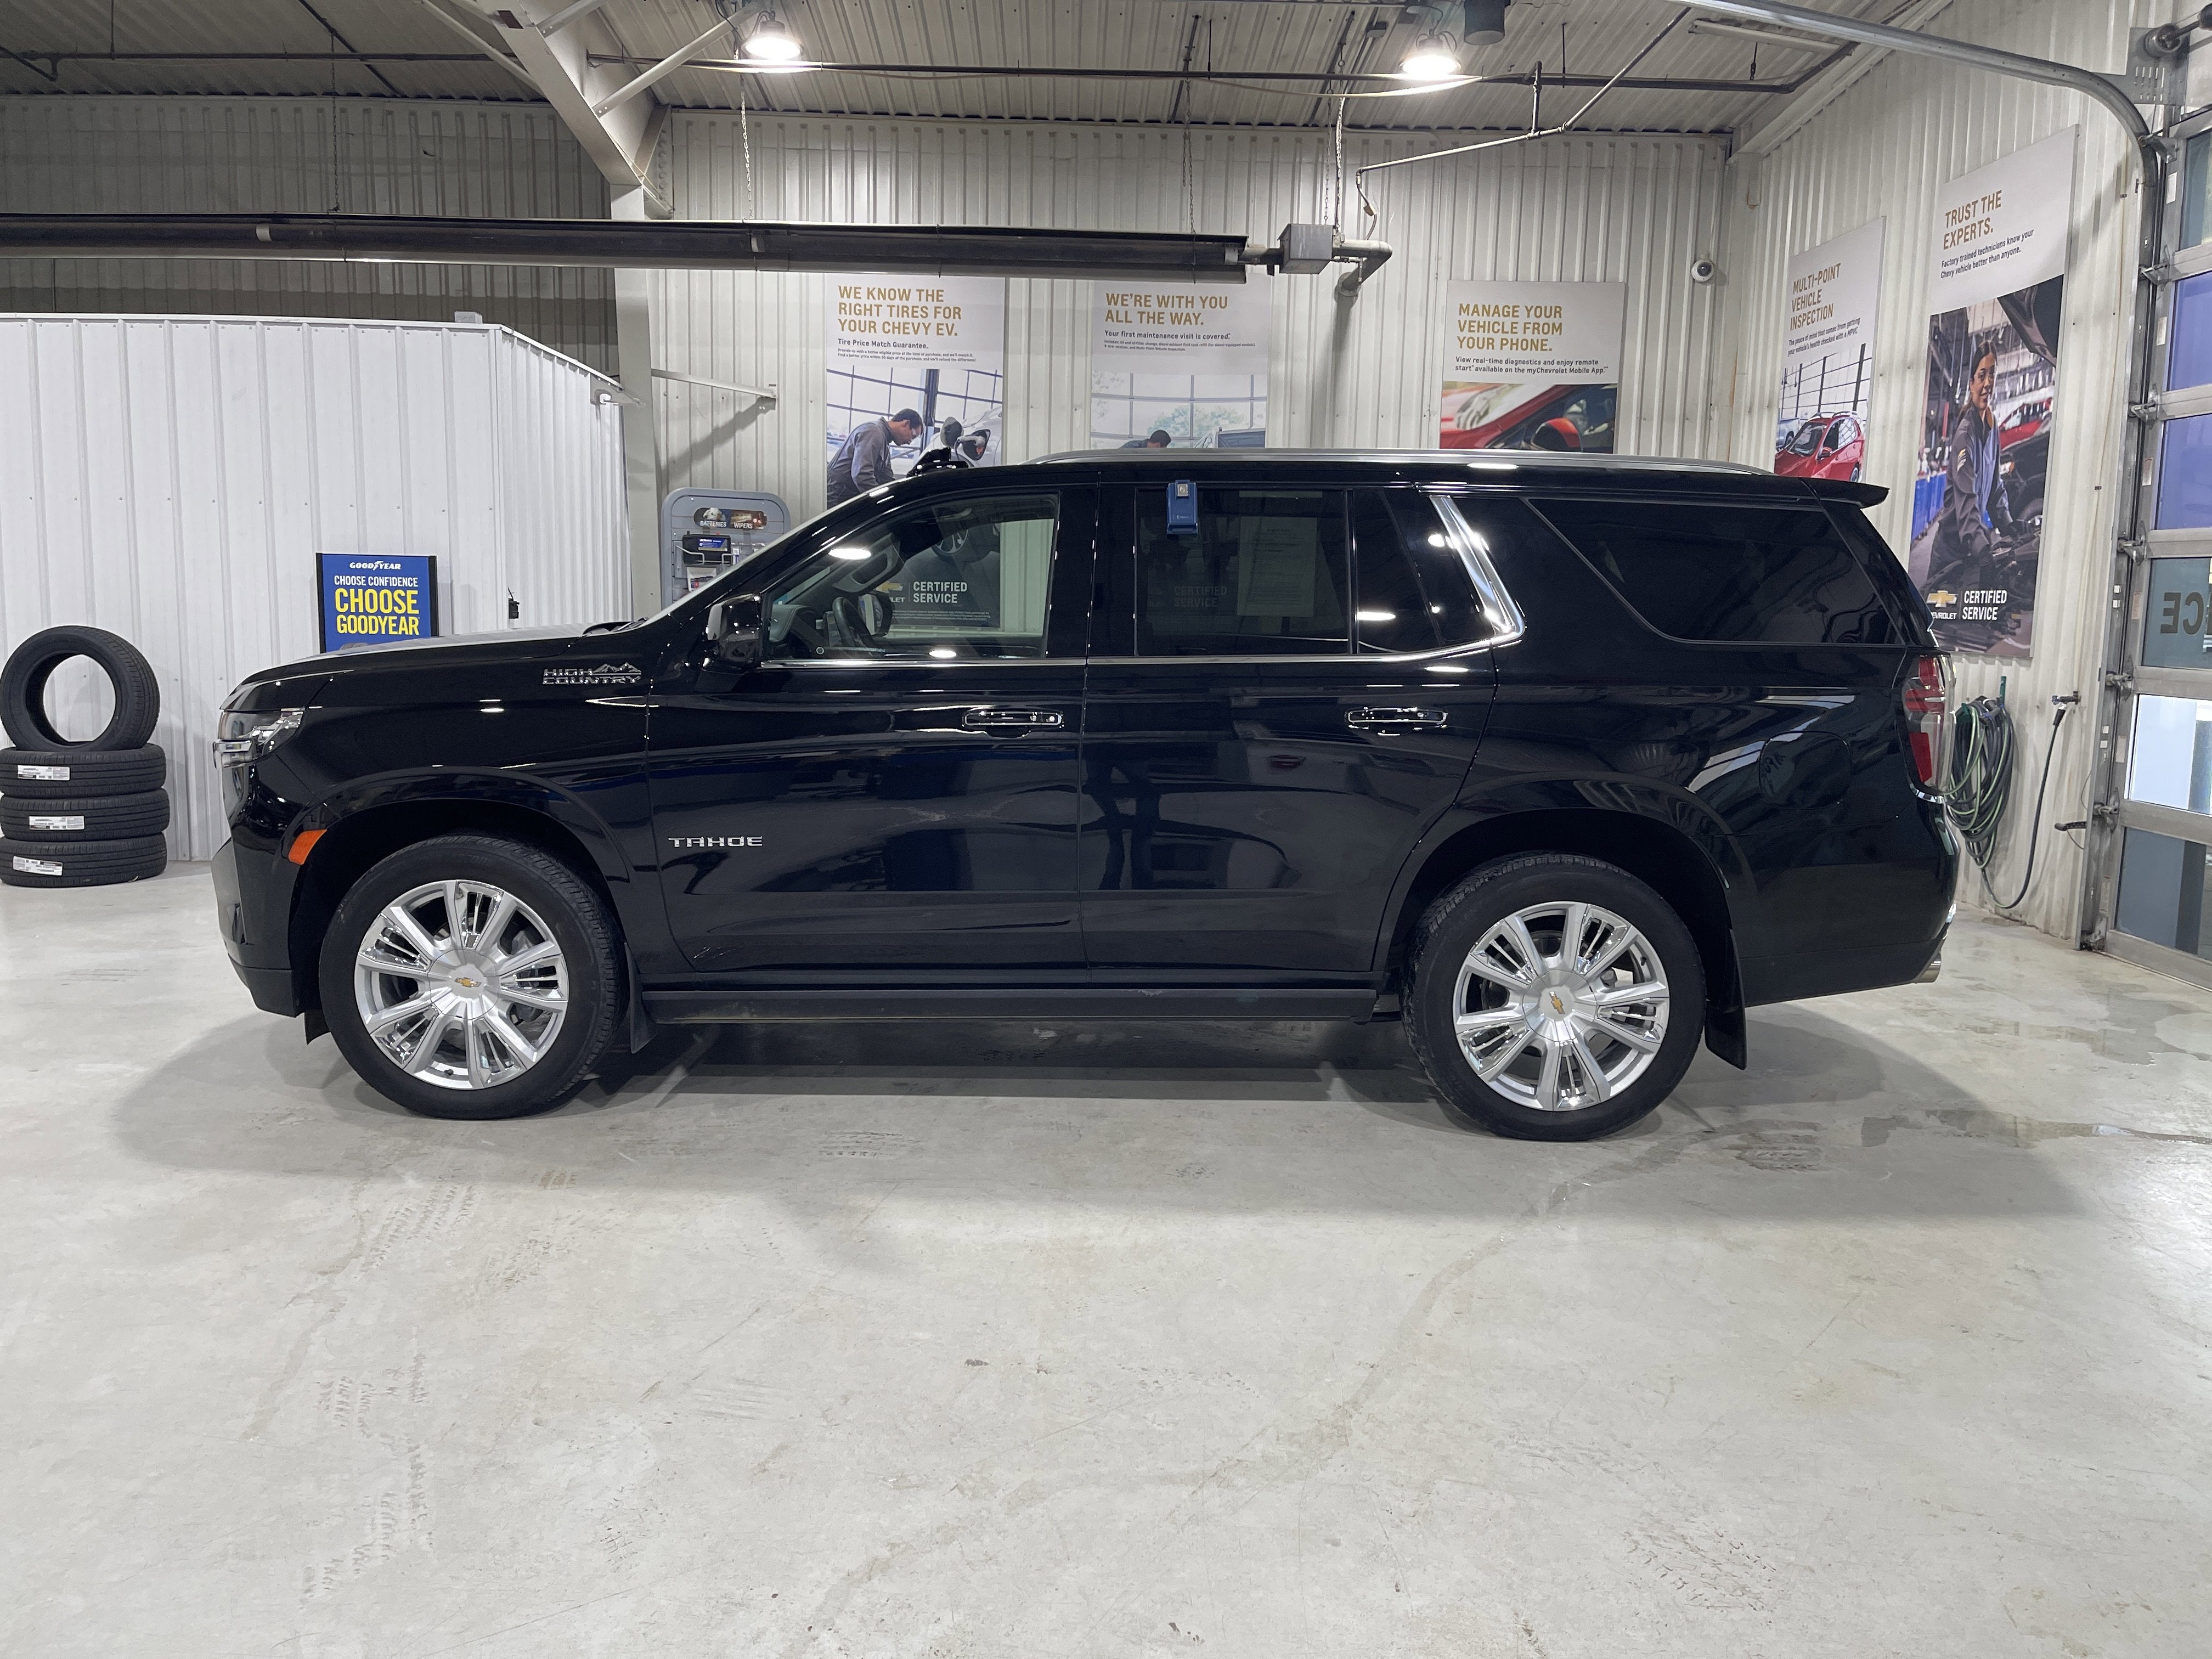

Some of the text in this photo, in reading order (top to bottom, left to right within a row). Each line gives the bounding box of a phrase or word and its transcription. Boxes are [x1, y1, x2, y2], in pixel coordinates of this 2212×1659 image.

[1945, 190, 2002, 228] TRUST THE
[1944, 217, 1993, 250] EXPERTS.
[1942, 230, 2034, 268] Factory trained technicians know your
[1940, 247, 2021, 278] Chevy vehicle better than anyone.
[1793, 263, 1841, 295] MULTI-POINT
[838, 286, 944, 302] WE KNOW THE
[1105, 293, 1228, 309] WE'RE WITH YOU
[1792, 289, 1822, 312] VEHICLE
[838, 303, 961, 320] RIGHT TIRES FOR
[1105, 310, 1204, 325] ALL THE WAY.
[1459, 303, 1562, 318] MANAGE YOUR
[1790, 303, 1833, 331] INSPECTION
[838, 319, 958, 336] YOUR CHEVY EV.
[1458, 320, 1562, 335] VEHICLE FROM
[1457, 336, 1552, 351] YOUR PHONE.
[349, 561, 402, 571] GOODYEAR
[334, 575, 418, 587] CHOOSE CONFIDENCE
[913, 582, 967, 592] CERTIFIED
[335, 588, 419, 614] CHOOSE
[913, 593, 958, 603] SERVICE
[1963, 590, 2007, 604] CERTIFIED
[1962, 607, 1998, 620] SERVICE
[336, 614, 420, 635] GOODYEAR
[542, 676, 641, 685] COUNTRY
[668, 836, 763, 848] TAHOE
